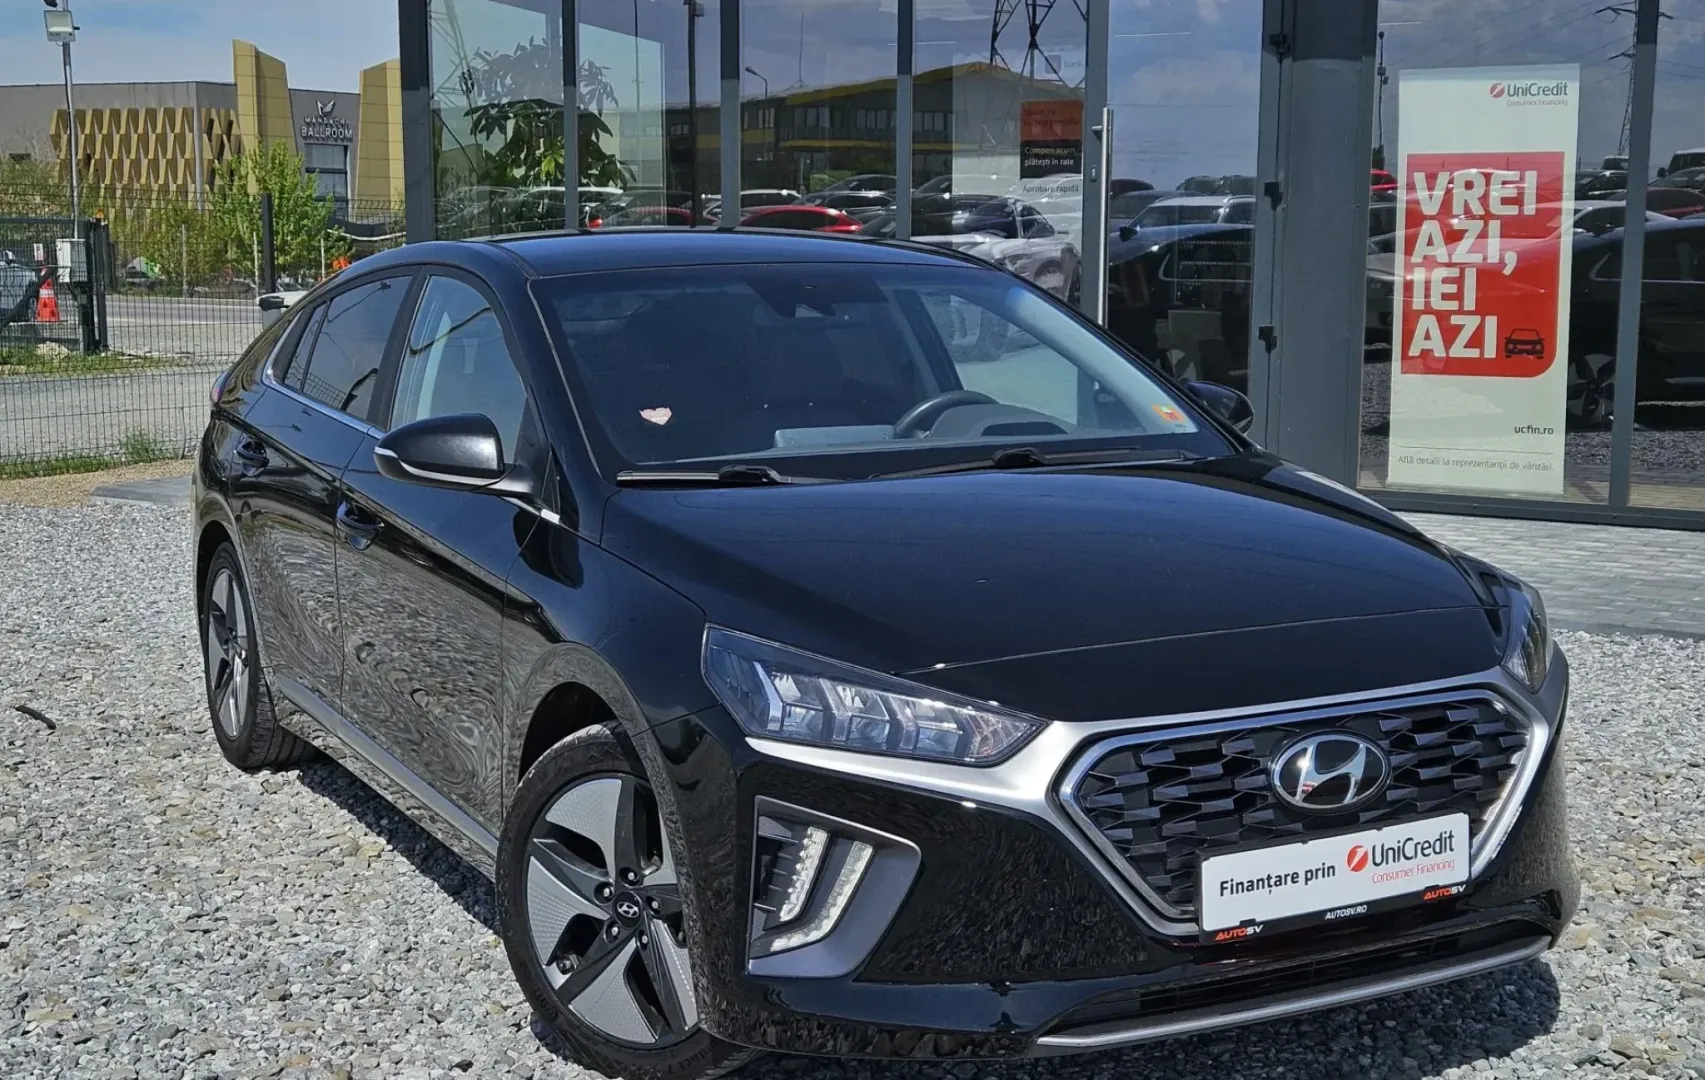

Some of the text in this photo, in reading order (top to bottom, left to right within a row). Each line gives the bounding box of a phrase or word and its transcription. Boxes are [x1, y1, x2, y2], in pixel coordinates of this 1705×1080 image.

[1507, 81, 1568, 97] UniCredit
[301, 127, 352, 138] BALLROOM
[1413, 170, 1538, 216] VREI
[1410, 219, 1518, 276] AZI,
[1412, 266, 1477, 311] IEI
[1408, 313, 1498, 359] AZI
[1514, 424, 1554, 435] ucfin.ro
[1442, 457, 1451, 466] la
[1509, 461, 1520, 470] de
[1220, 829, 1455, 897] Finanțare prin UniCredit
[1371, 858, 1455, 884] Consumer Financing
[1423, 884, 1467, 900] AUTOSV
[1325, 904, 1368, 920] AUTOSV.RO
[1215, 924, 1264, 941] AUTOSV
